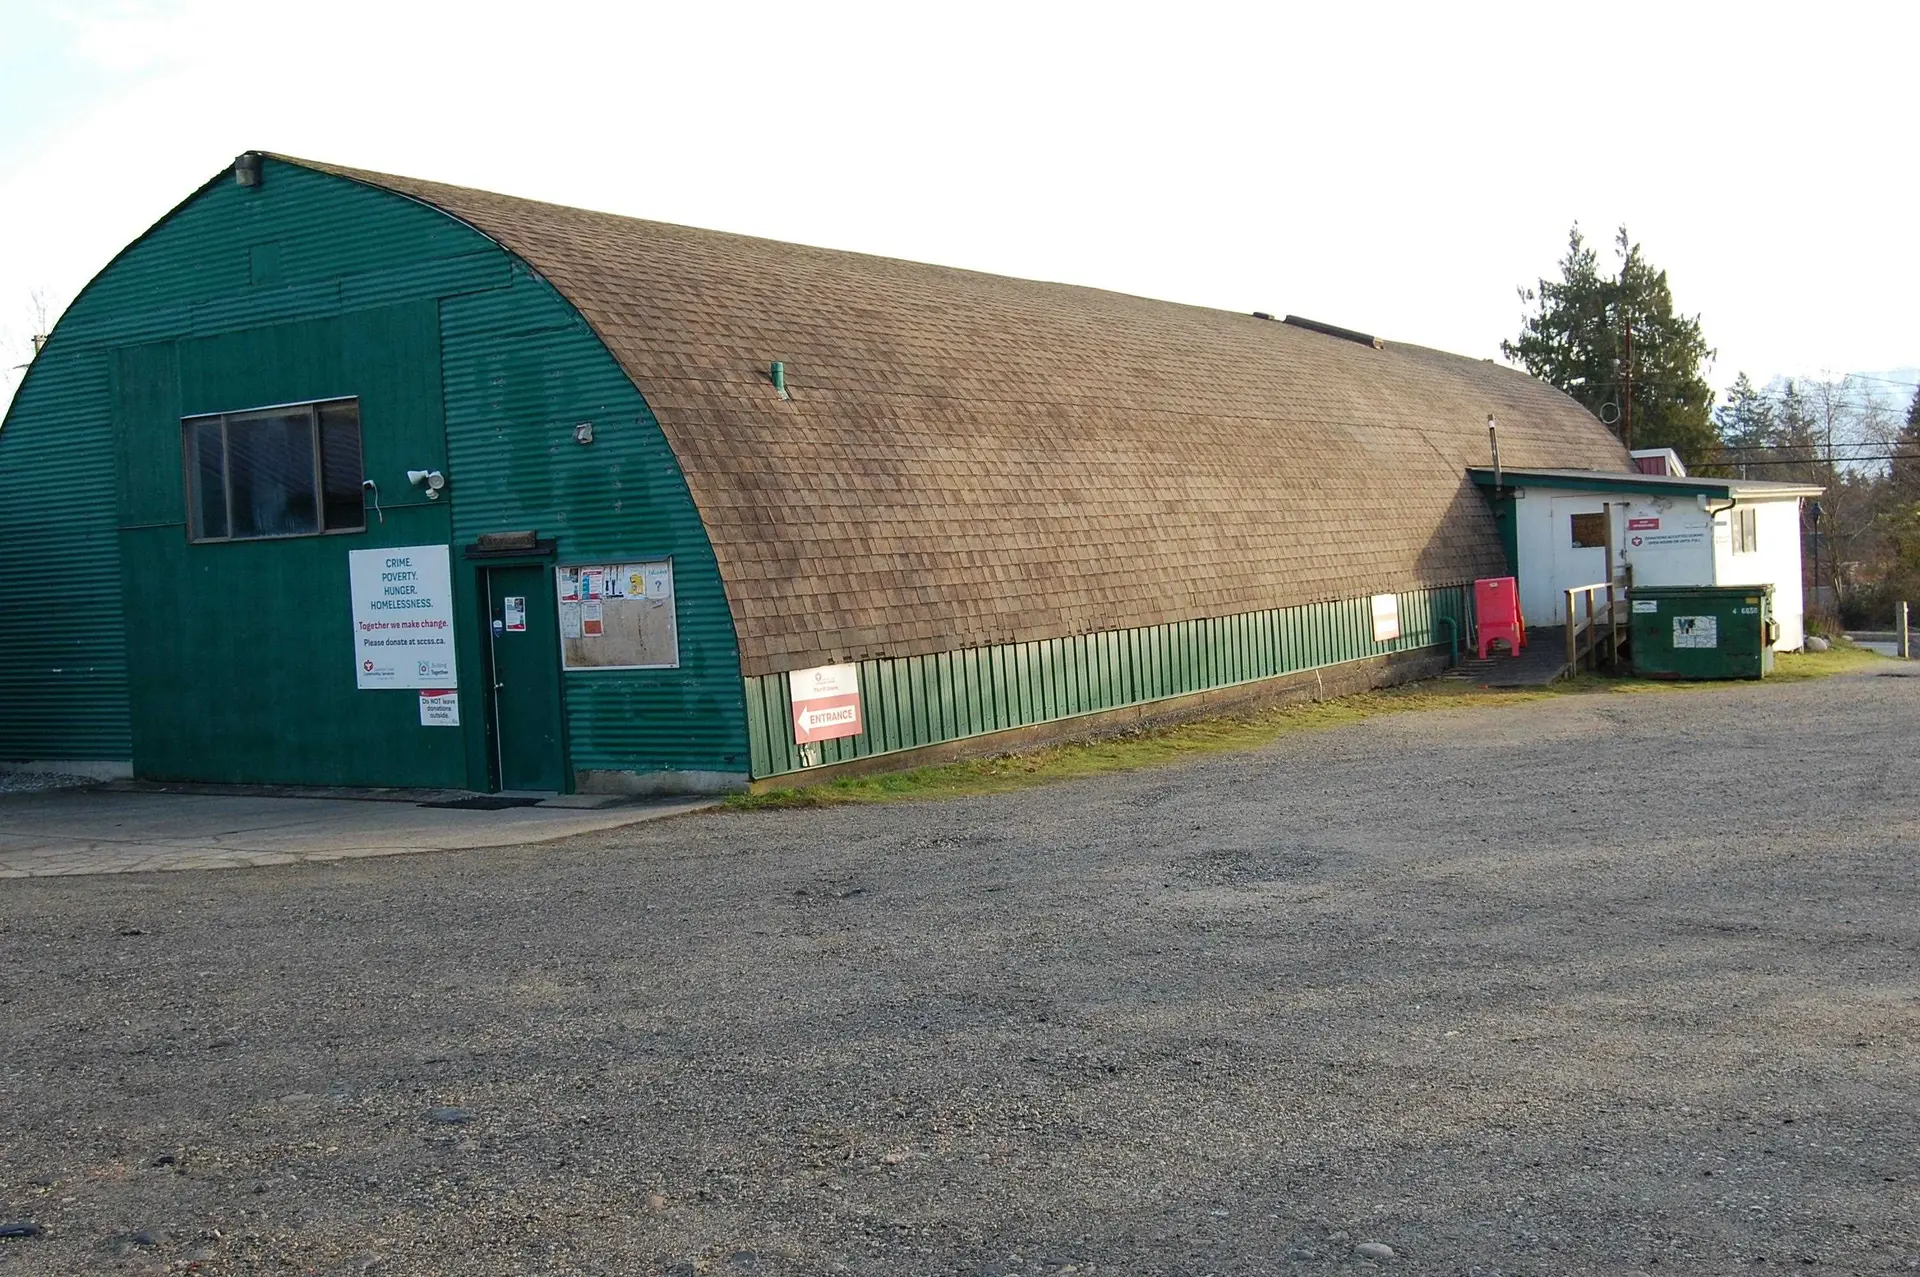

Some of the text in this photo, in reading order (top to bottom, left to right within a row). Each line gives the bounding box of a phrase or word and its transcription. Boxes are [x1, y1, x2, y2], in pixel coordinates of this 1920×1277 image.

[386, 557, 412, 568] CRIME.
[382, 571, 418, 582] POVERTY.
[384, 586, 418, 596] HUNGER.
[370, 598, 433, 610] HOMELESSNESS.
[359, 621, 389, 631] Together
[402, 620, 419, 628] make
[421, 619, 448, 629] change.
[364, 638, 384, 646] Please
[386, 638, 407, 646] donate
[810, 710, 852, 724] ENTRANCE
